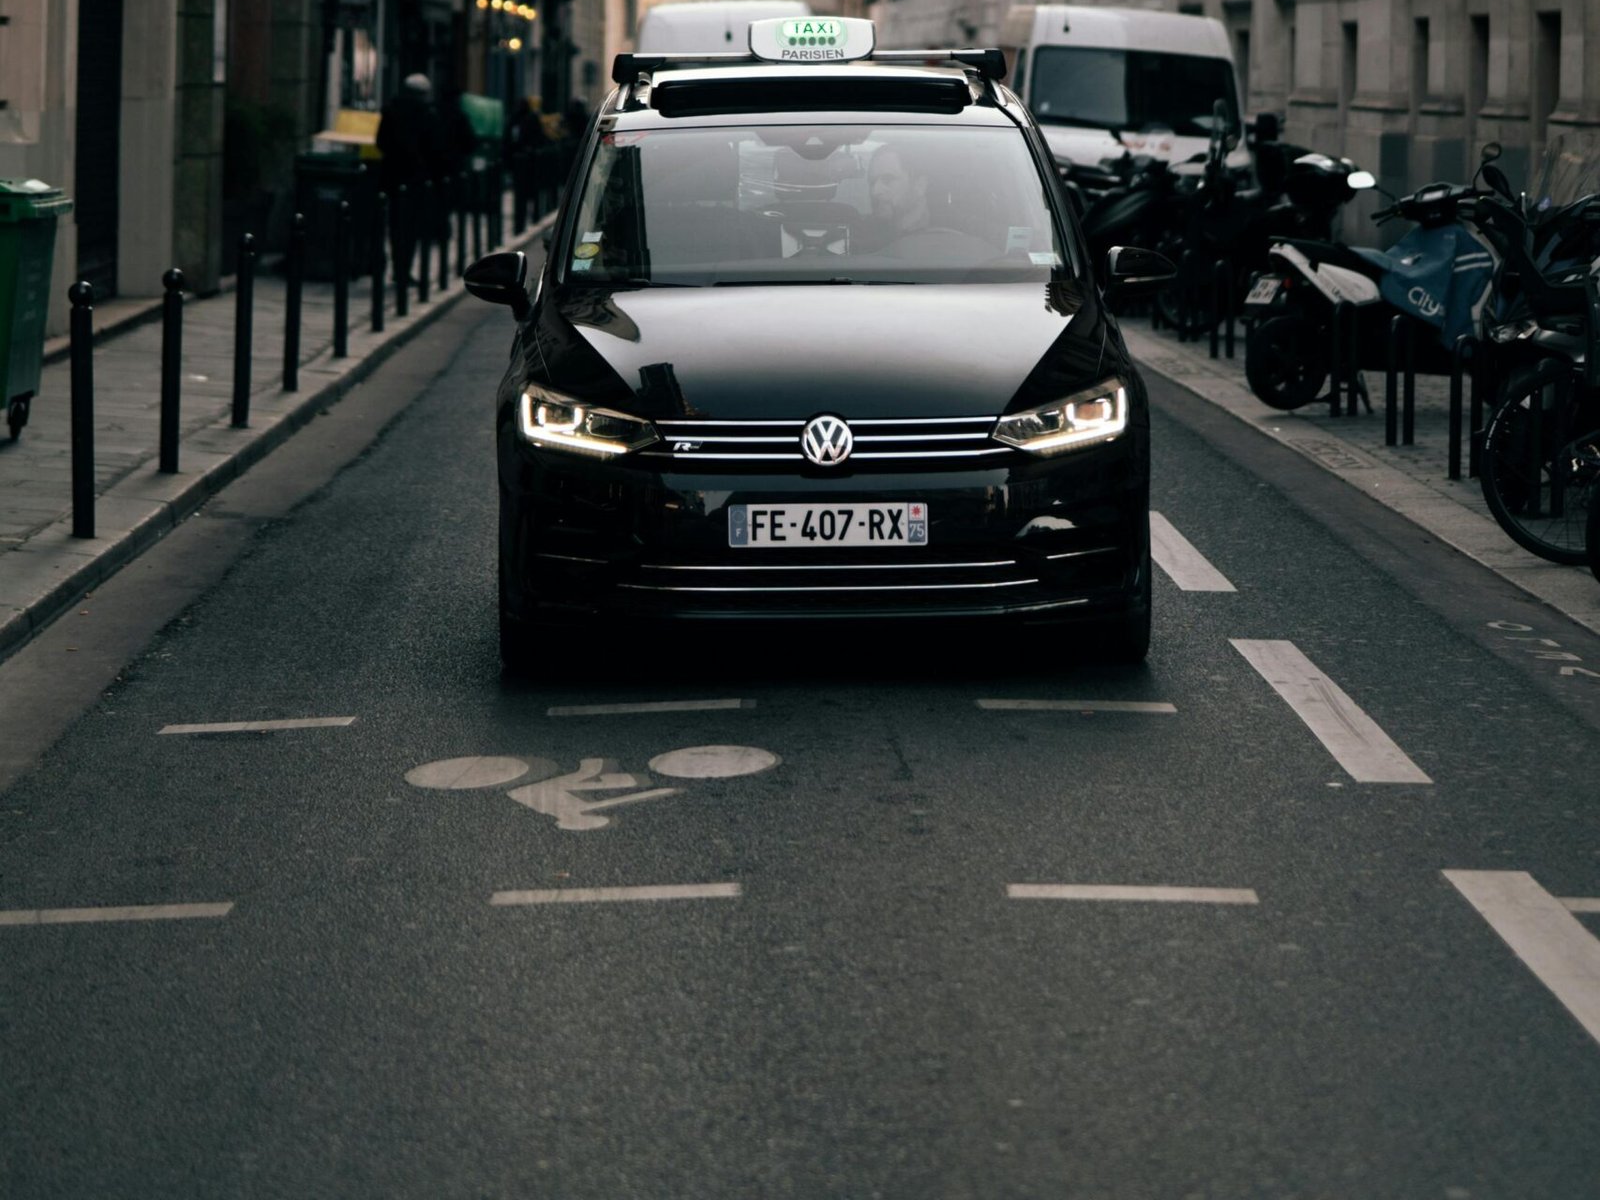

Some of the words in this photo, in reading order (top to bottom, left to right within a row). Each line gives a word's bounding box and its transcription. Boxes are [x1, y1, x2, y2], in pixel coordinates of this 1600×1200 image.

[795, 22, 834, 33] TAXI
[781, 48, 845, 60] PARISIEN
[736, 528, 741, 538] F
[751, 508, 904, 541] FE-407-RX
[909, 523, 924, 538] 75
